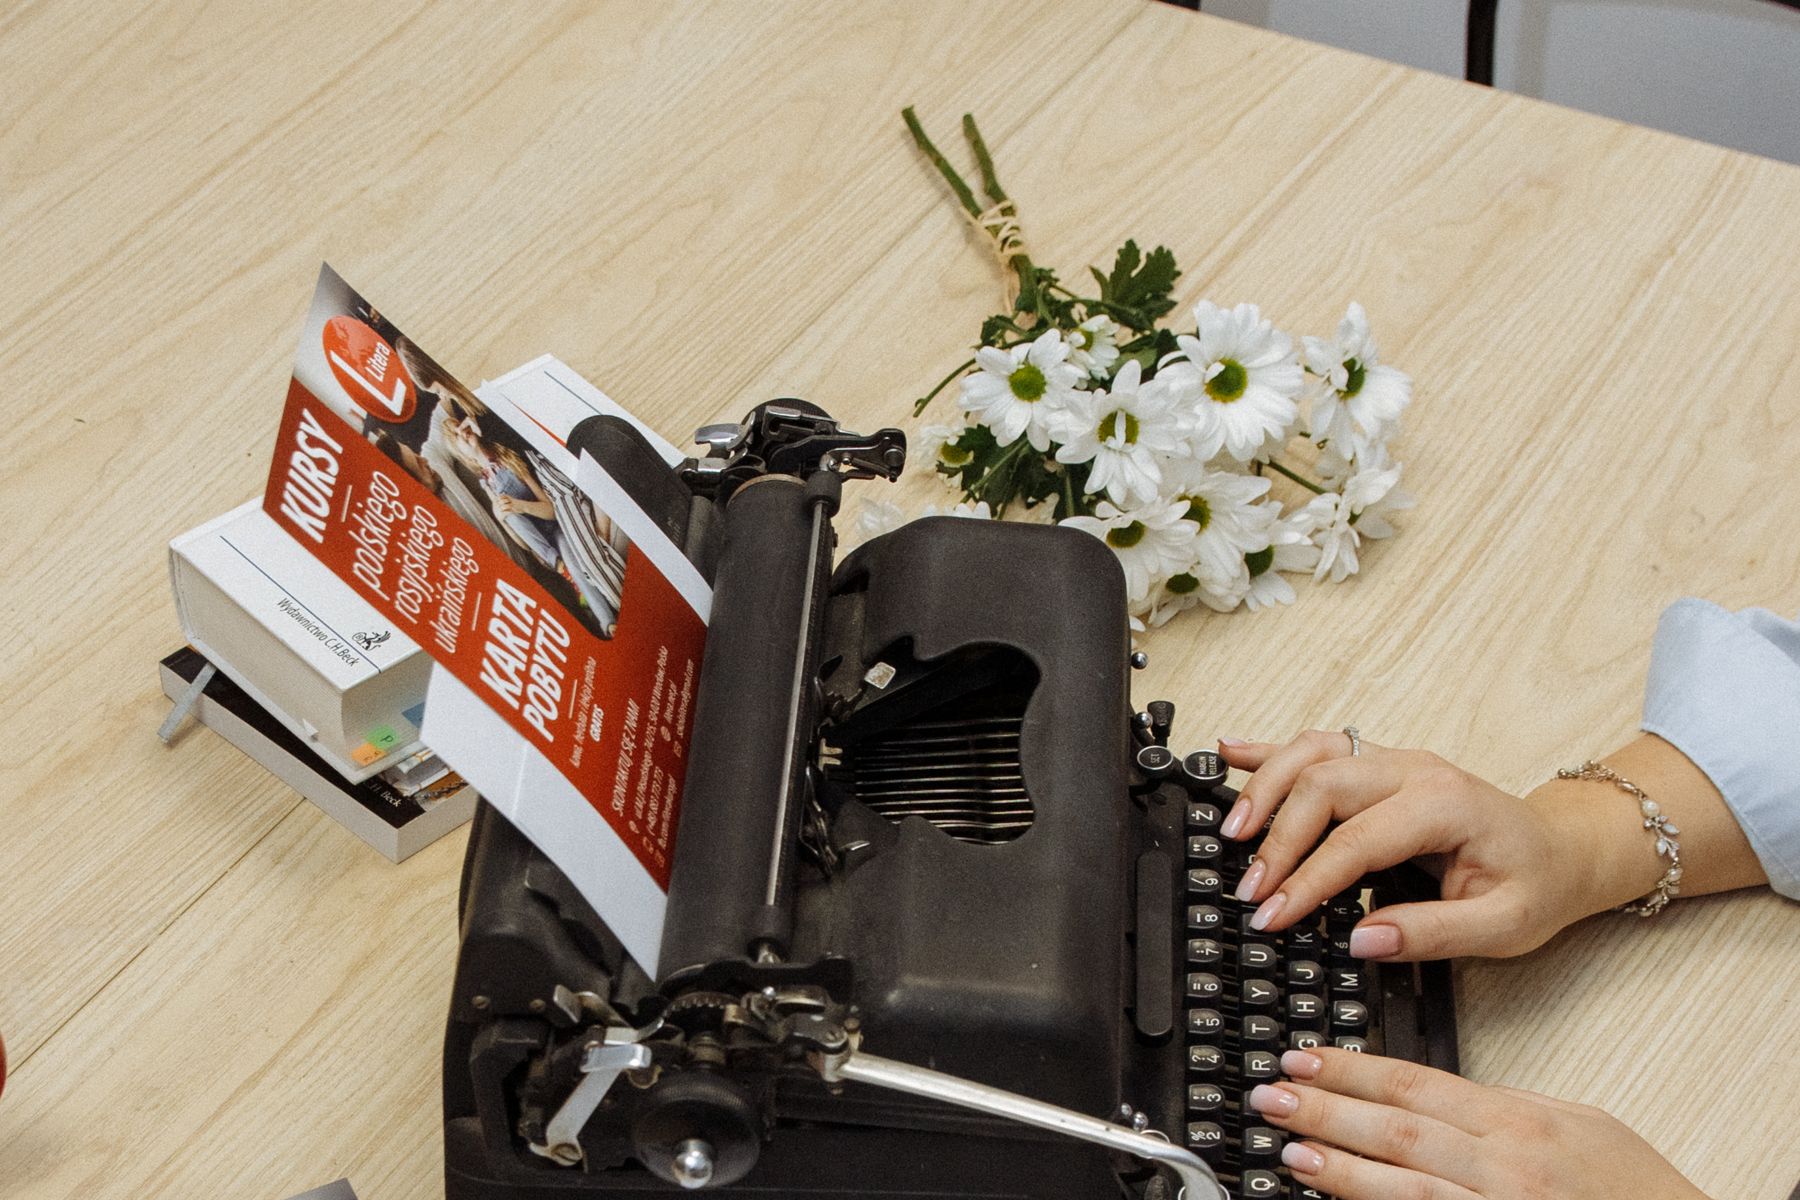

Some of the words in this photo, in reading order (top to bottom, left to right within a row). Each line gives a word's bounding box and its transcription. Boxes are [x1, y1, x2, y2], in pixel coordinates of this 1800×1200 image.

[364, 341, 391, 382] Litera
[280, 408, 344, 543] KURSY
[351, 470, 408, 601] polskiego
[395, 505, 445, 623] rosyjskiego
[434, 536, 480, 653] ukraińskiego
[277, 598, 328, 642] Wydawnictwo
[479, 578, 538, 709] KARTA
[522, 608, 571, 742] POBYTU
[625, 698, 640, 728] NAMI
[590, 704, 604, 742] GRATIS
[621, 735, 637, 753] SIĘ
[1150, 753, 1160, 764] SET
[1199, 755, 1207, 775] MARGIN
[1208, 755, 1217, 775] RELEASE
[612, 751, 633, 816] SKONTAKTUJ
[1191, 809, 1214, 822] Ż
[1204, 877, 1219, 886] 9
[1204, 913, 1219, 922] 8
[1295, 932, 1314, 943] K
[1205, 947, 1219, 956] 7
[1249, 950, 1268, 962] U
[1296, 968, 1314, 979] J
[1341, 973, 1359, 986] M
[1204, 983, 1218, 991] 6
[1251, 986, 1270, 998] Y
[1297, 1001, 1315, 1013] H
[1340, 1007, 1358, 1020] N
[1206, 1018, 1220, 1026] 5
[1252, 1023, 1270, 1034] T
[1298, 1038, 1318, 1050] G
[1206, 1053, 1221, 1064] 4
[1252, 1059, 1271, 1071] R
[1206, 1092, 1222, 1103] 3
[1206, 1130, 1221, 1140] 2
[1253, 1134, 1272, 1149] W
[1251, 1177, 1275, 1191] Q
[1303, 1188, 1322, 1199] A
